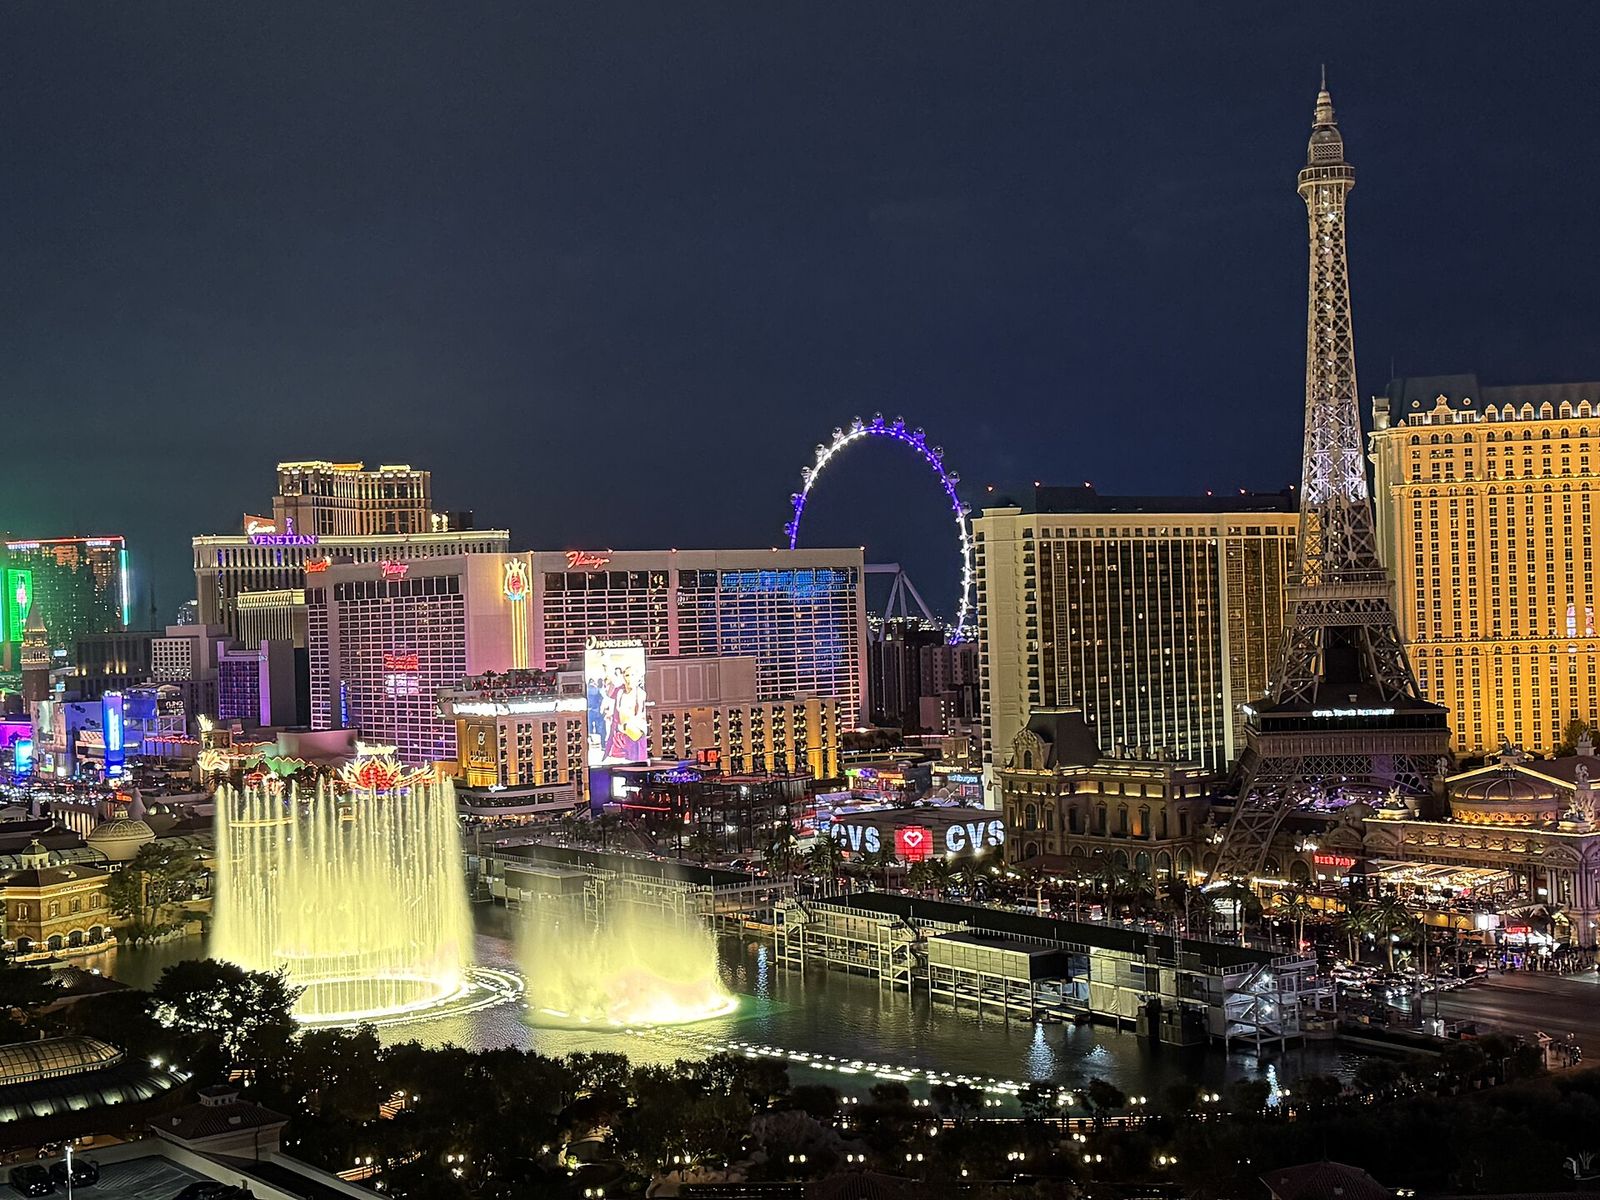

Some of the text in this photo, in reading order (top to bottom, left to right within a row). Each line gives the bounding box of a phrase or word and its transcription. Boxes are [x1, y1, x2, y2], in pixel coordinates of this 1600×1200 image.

[250, 535, 316, 545] VENETIAN
[831, 823, 881, 853] CVS
[946, 820, 1005, 852] CVS
[1314, 855, 1356, 866] BEER PARK
